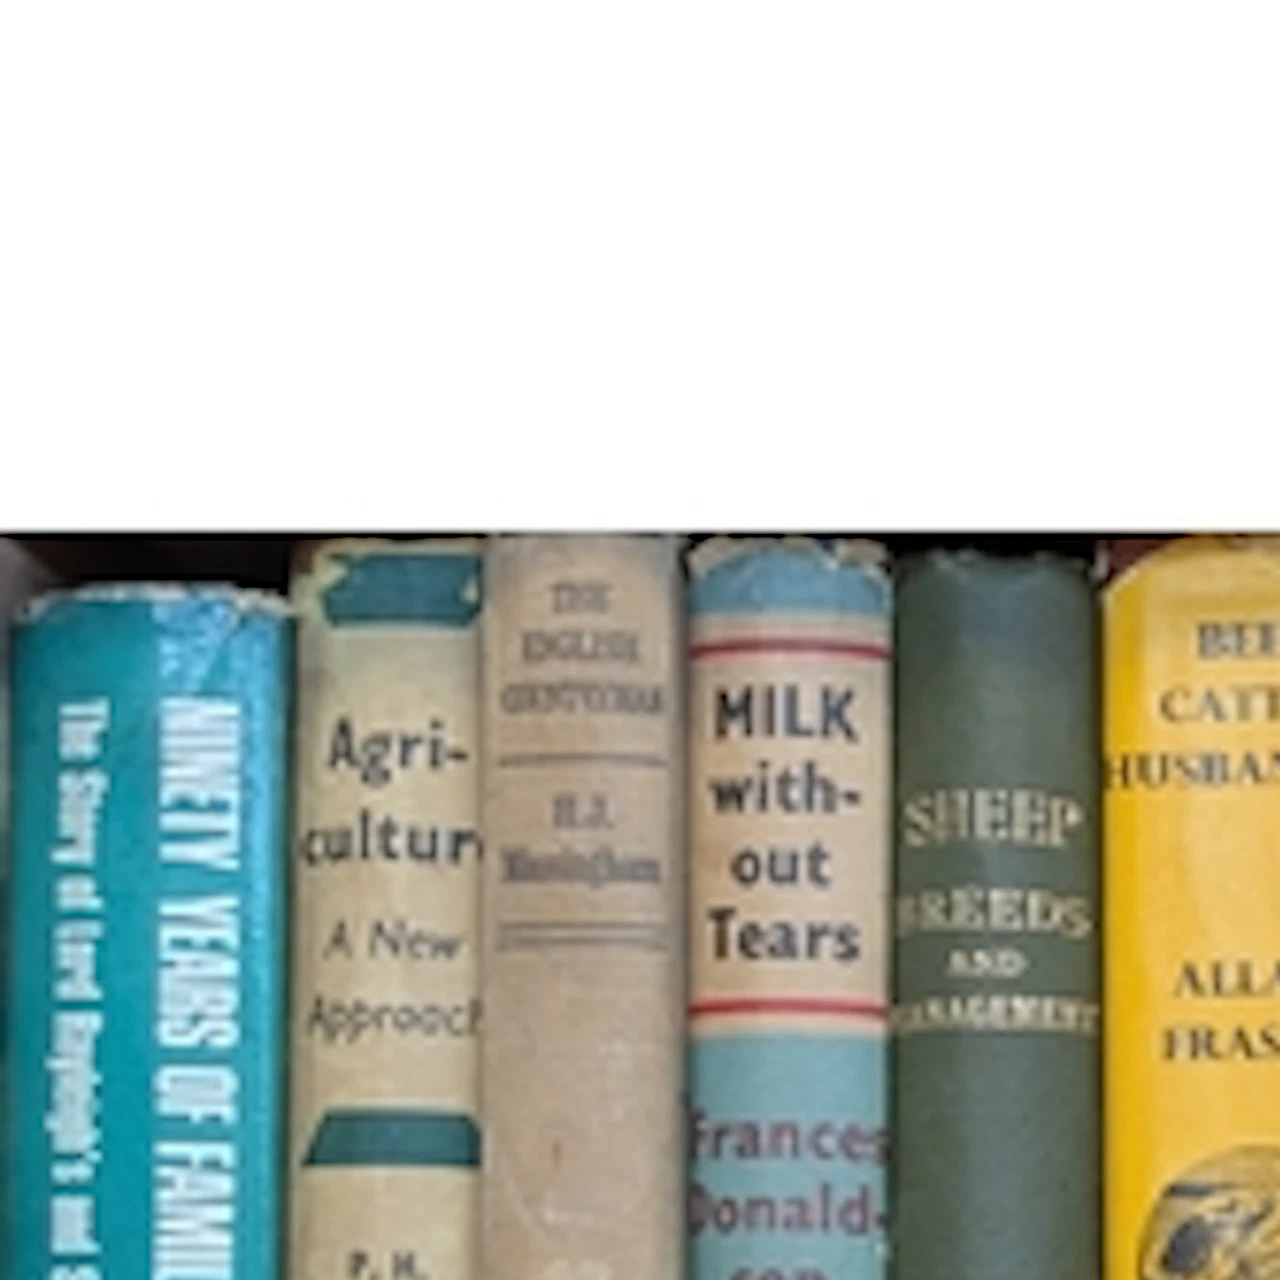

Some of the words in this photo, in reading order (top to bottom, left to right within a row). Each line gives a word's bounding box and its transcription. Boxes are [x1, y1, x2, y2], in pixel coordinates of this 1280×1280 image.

[57, 700, 109, 761] The
[712, 684, 860, 742] MILK
[327, 716, 469, 785] Agri-
[157, 698, 242, 870] NINETY
[706, 758, 862, 816] with-
[904, 787, 1085, 847] SHEEP
[728, 841, 833, 887] out
[57, 876, 103, 912] of
[322, 920, 353, 959] A
[705, 906, 862, 963] Tears
[156, 897, 241, 1048] YEARS
[152, 1063, 239, 1126] OF
